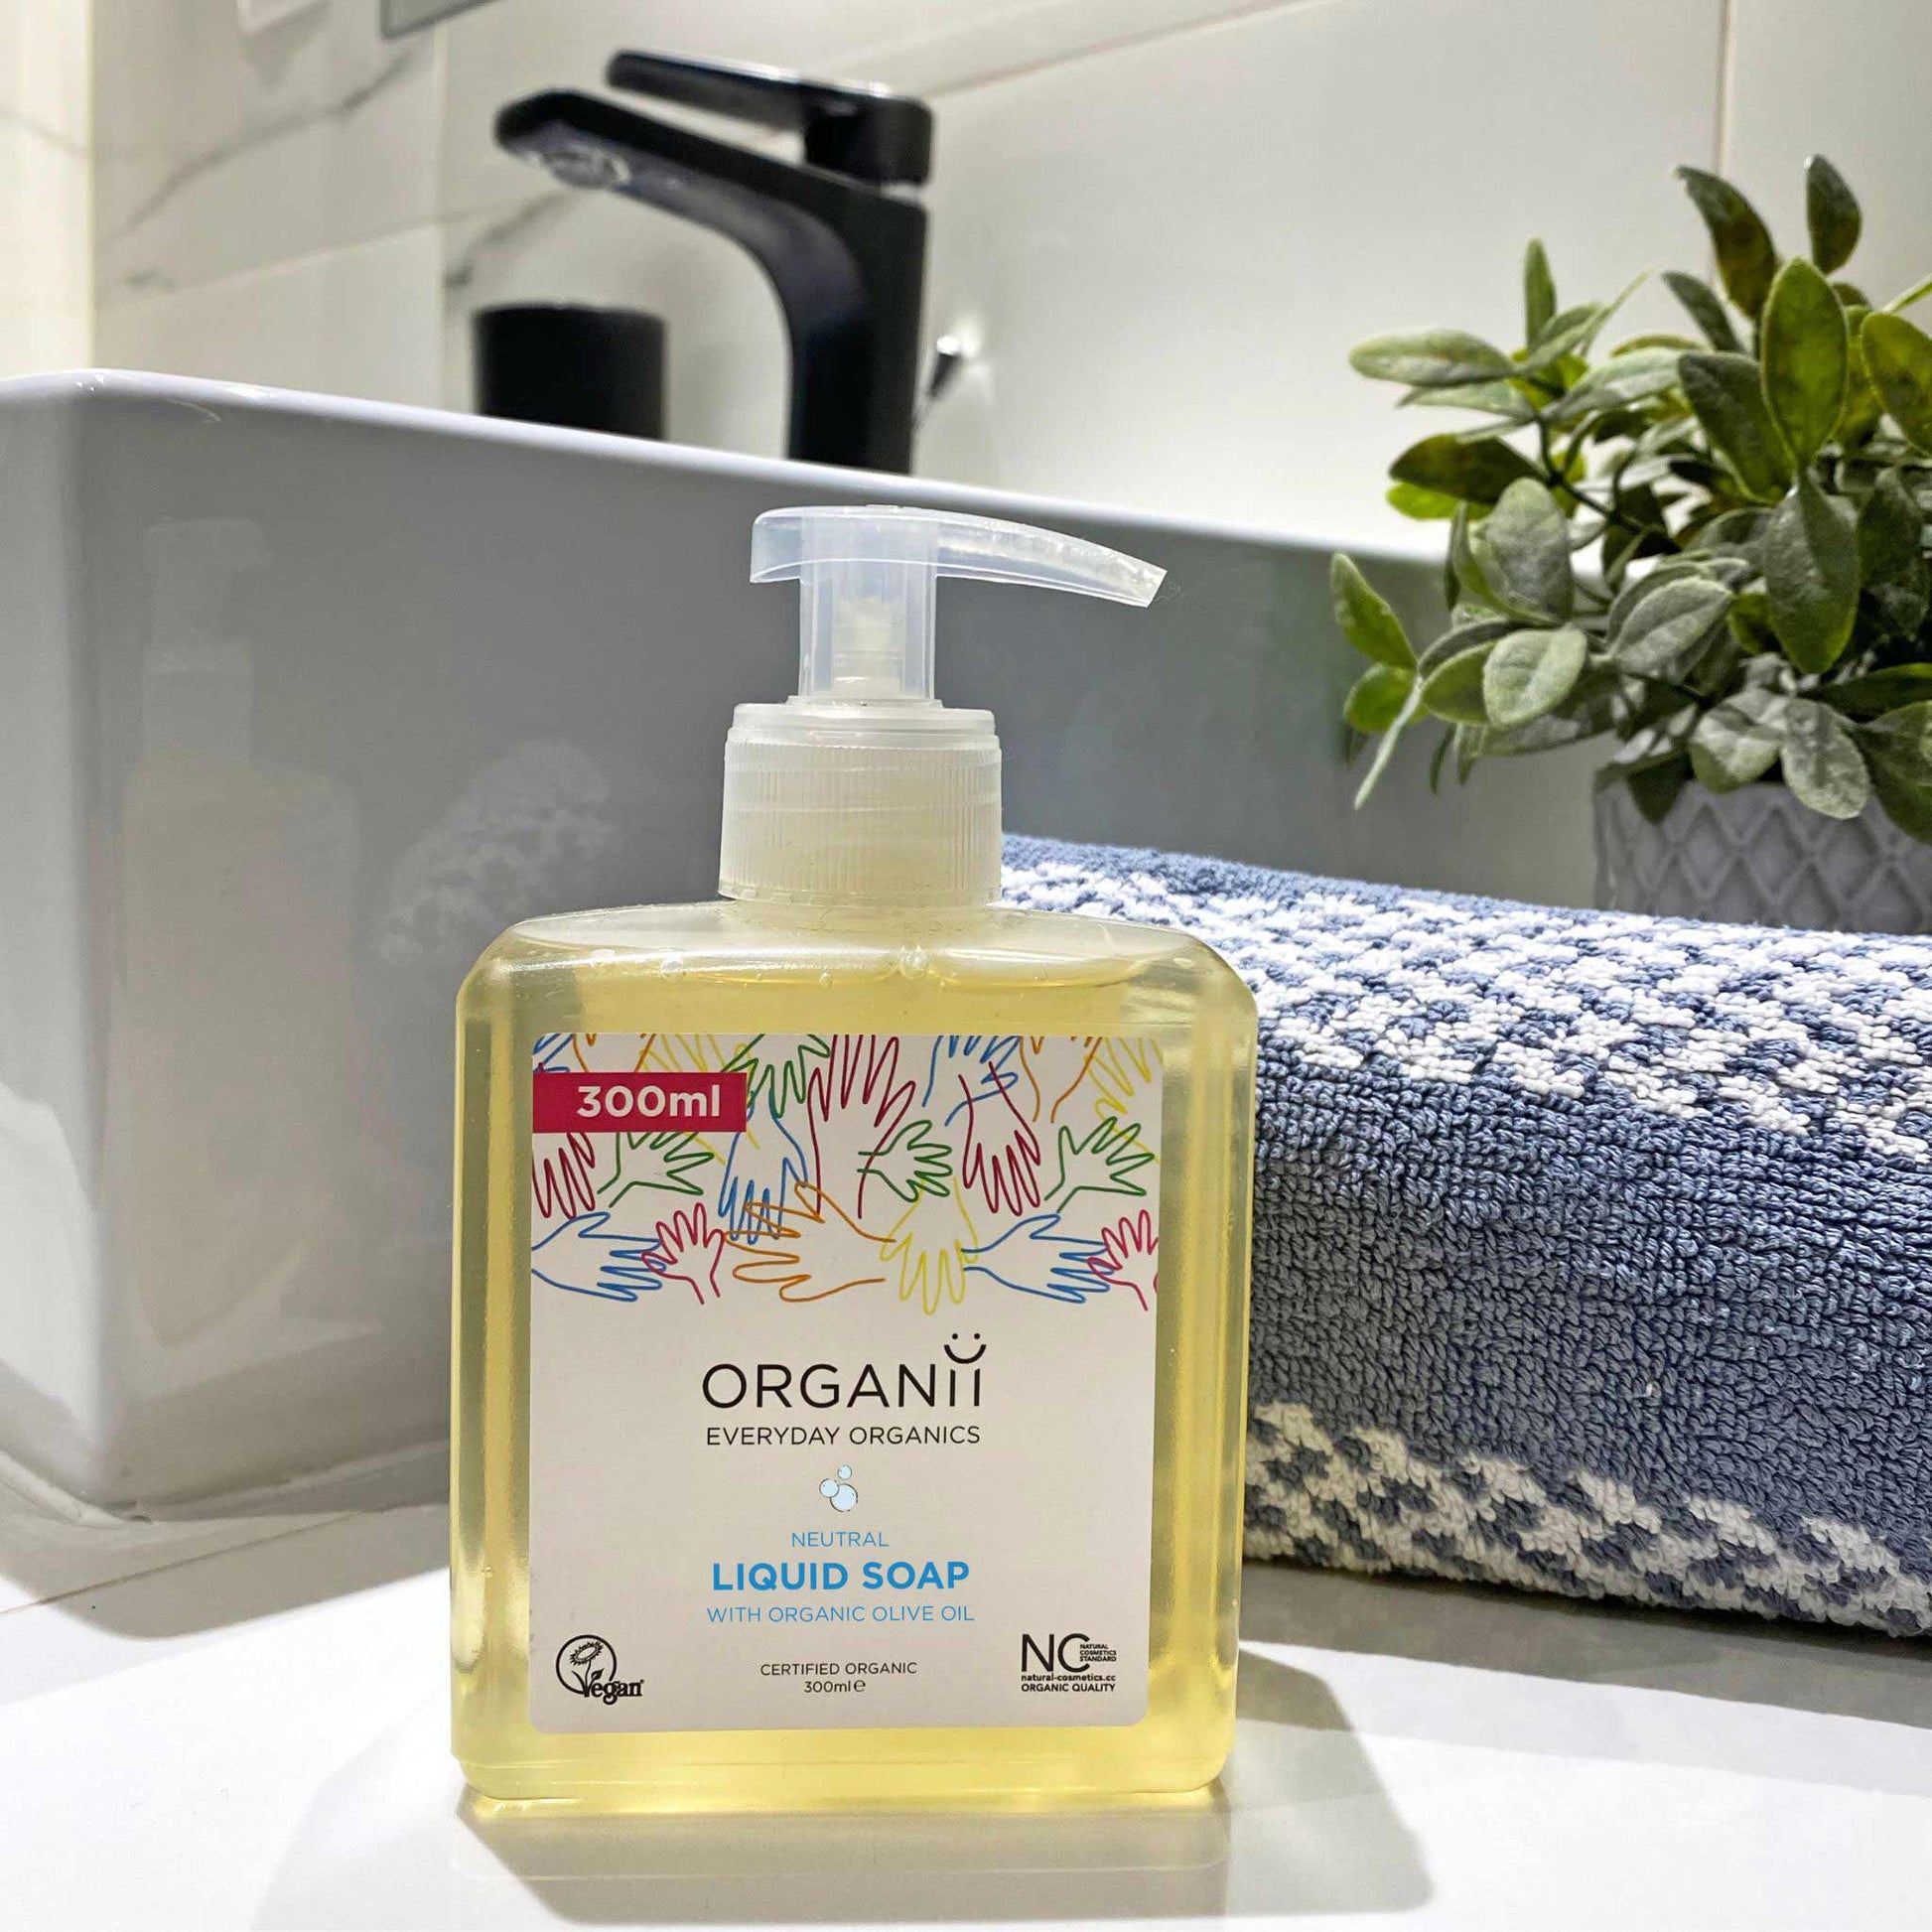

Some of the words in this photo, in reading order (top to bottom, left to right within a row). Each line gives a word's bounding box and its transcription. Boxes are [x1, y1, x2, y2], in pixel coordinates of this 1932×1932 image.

[577, 1084, 720, 1118] 300ml
[707, 1427, 840, 1446] EVERYDAY
[849, 1426, 981, 1445] ORGANICS
[791, 1532, 890, 1548] NEUTRAL
[712, 1562, 849, 1591] LIQUID
[862, 1561, 970, 1590] SOAP
[707, 1606, 761, 1623] WITH
[768, 1605, 866, 1622] ORGANIC
[872, 1605, 934, 1622] OLIVE
[941, 1604, 975, 1621] OIL
[1021, 1632, 1091, 1673] NC
[760, 1663, 840, 1676] CERTIFIED
[845, 1662, 917, 1675] ORGANIC
[1021, 1673, 1117, 1682] natural-cosmetics.cc
[1021, 1683, 1070, 1692] ORGANIC
[1071, 1683, 1116, 1692] QUALITY
